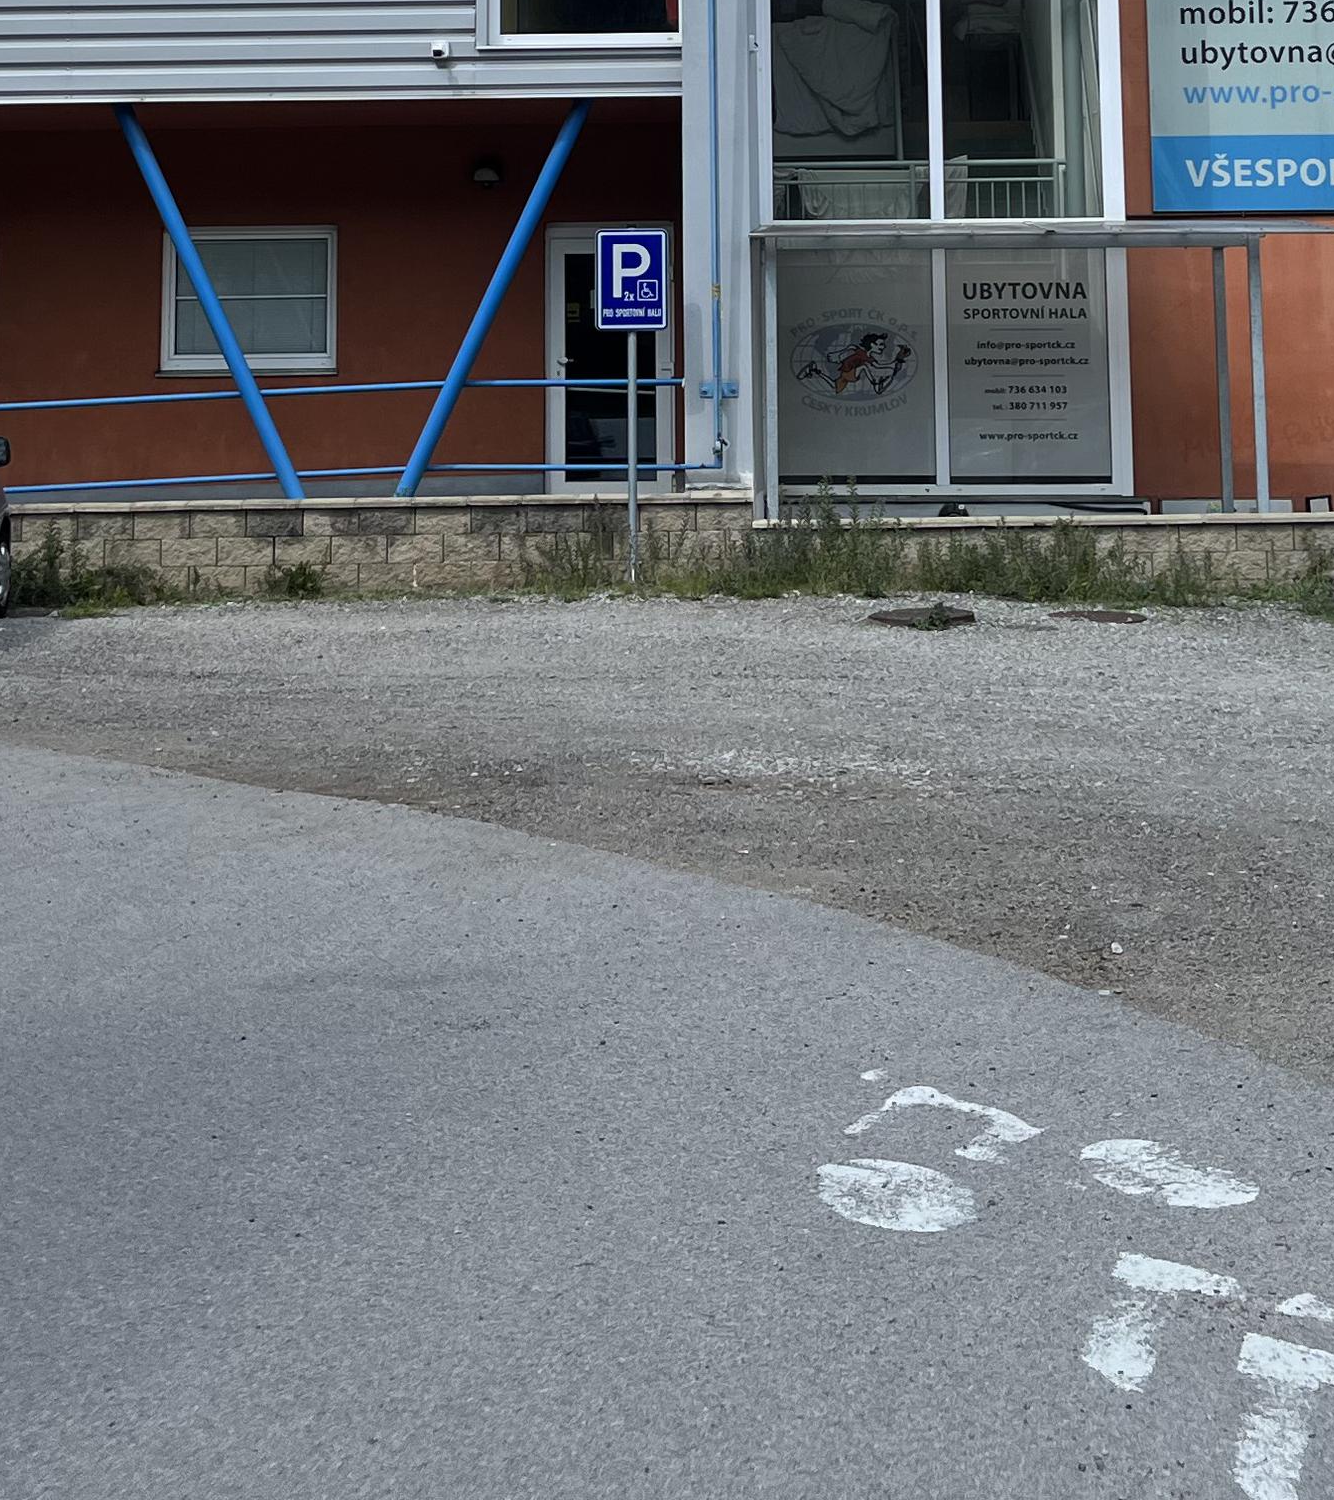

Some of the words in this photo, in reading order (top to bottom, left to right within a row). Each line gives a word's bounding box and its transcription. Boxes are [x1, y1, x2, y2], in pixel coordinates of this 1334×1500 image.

[1179, 0, 1274, 24] mobil:
[612, 243, 651, 298] P
[623, 291, 635, 301] 2x
[962, 282, 1087, 300] UBYTOVNA
[963, 305, 1045, 319] SPORTOVNÍ
[1049, 307, 1087, 319] HALA
[977, 340, 1075, 351] info@pro-sportck.cz
[964, 357, 1089, 368] ubytovna@pro-sportck.cz
[1008, 385, 1027, 394] 736
[1028, 385, 1047, 394] 634
[1050, 385, 1068, 394] 103
[1009, 402, 1027, 410] 380
[1030, 402, 1047, 410] 711
[1049, 402, 1068, 410] 957
[979, 431, 1079, 441] www.pro-sportck.cz
